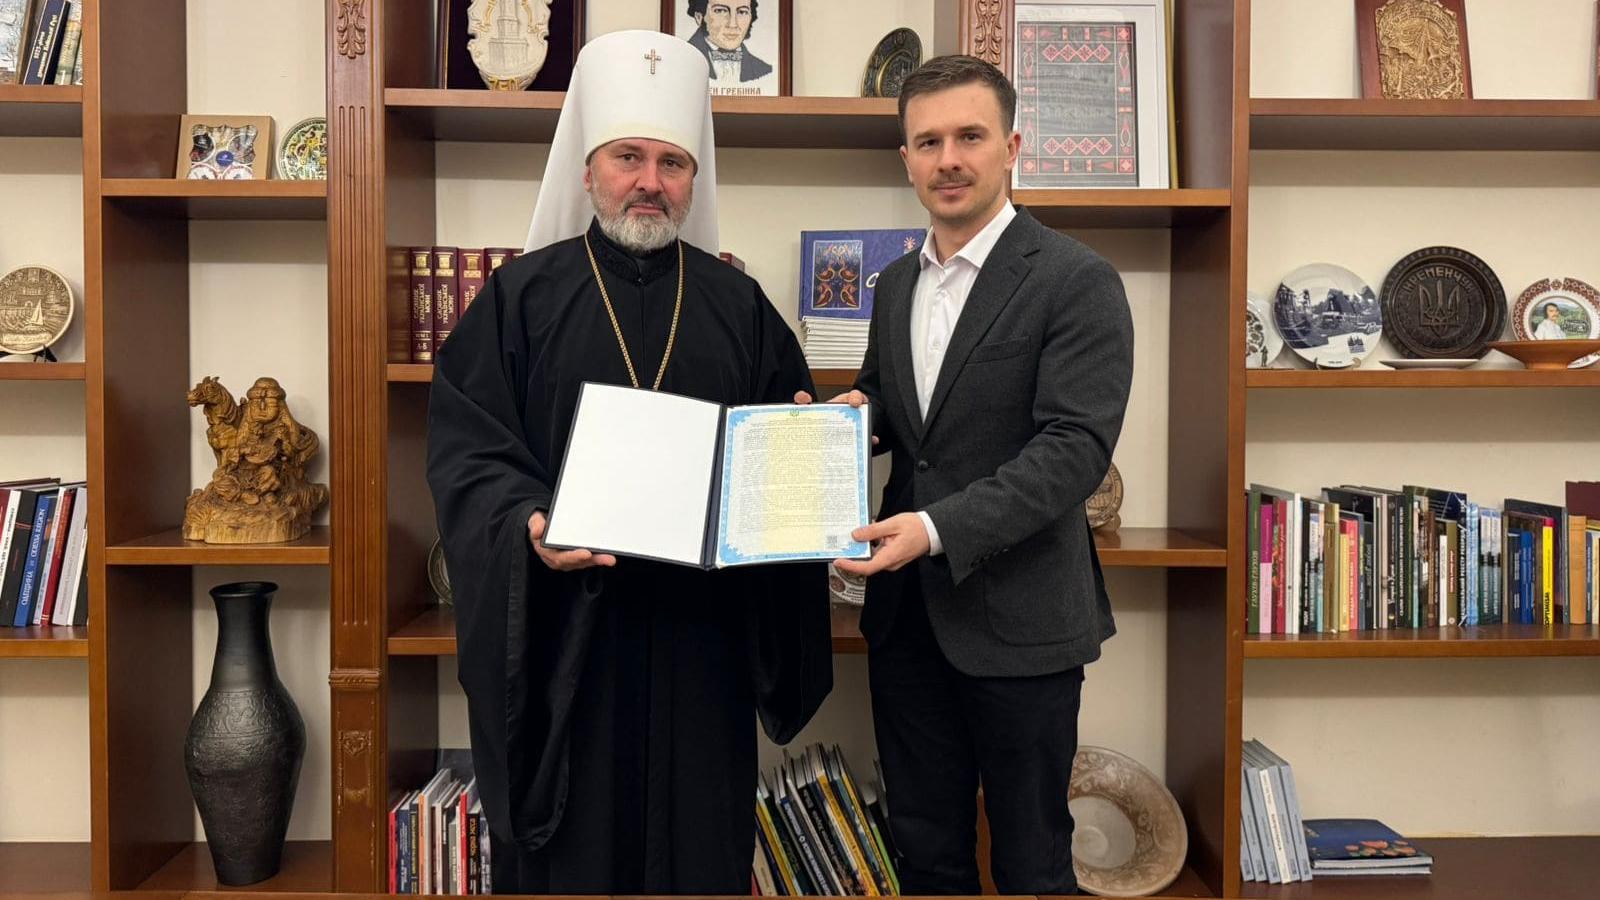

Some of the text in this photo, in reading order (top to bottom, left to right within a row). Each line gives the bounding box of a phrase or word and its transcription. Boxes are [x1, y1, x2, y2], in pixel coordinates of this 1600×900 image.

[721, 87, 761, 95] ГРЕБІНКА
[1402, 266, 1476, 294] КРЕМЕНЧУК
[30, 508, 46, 558] ODESSA REGION
